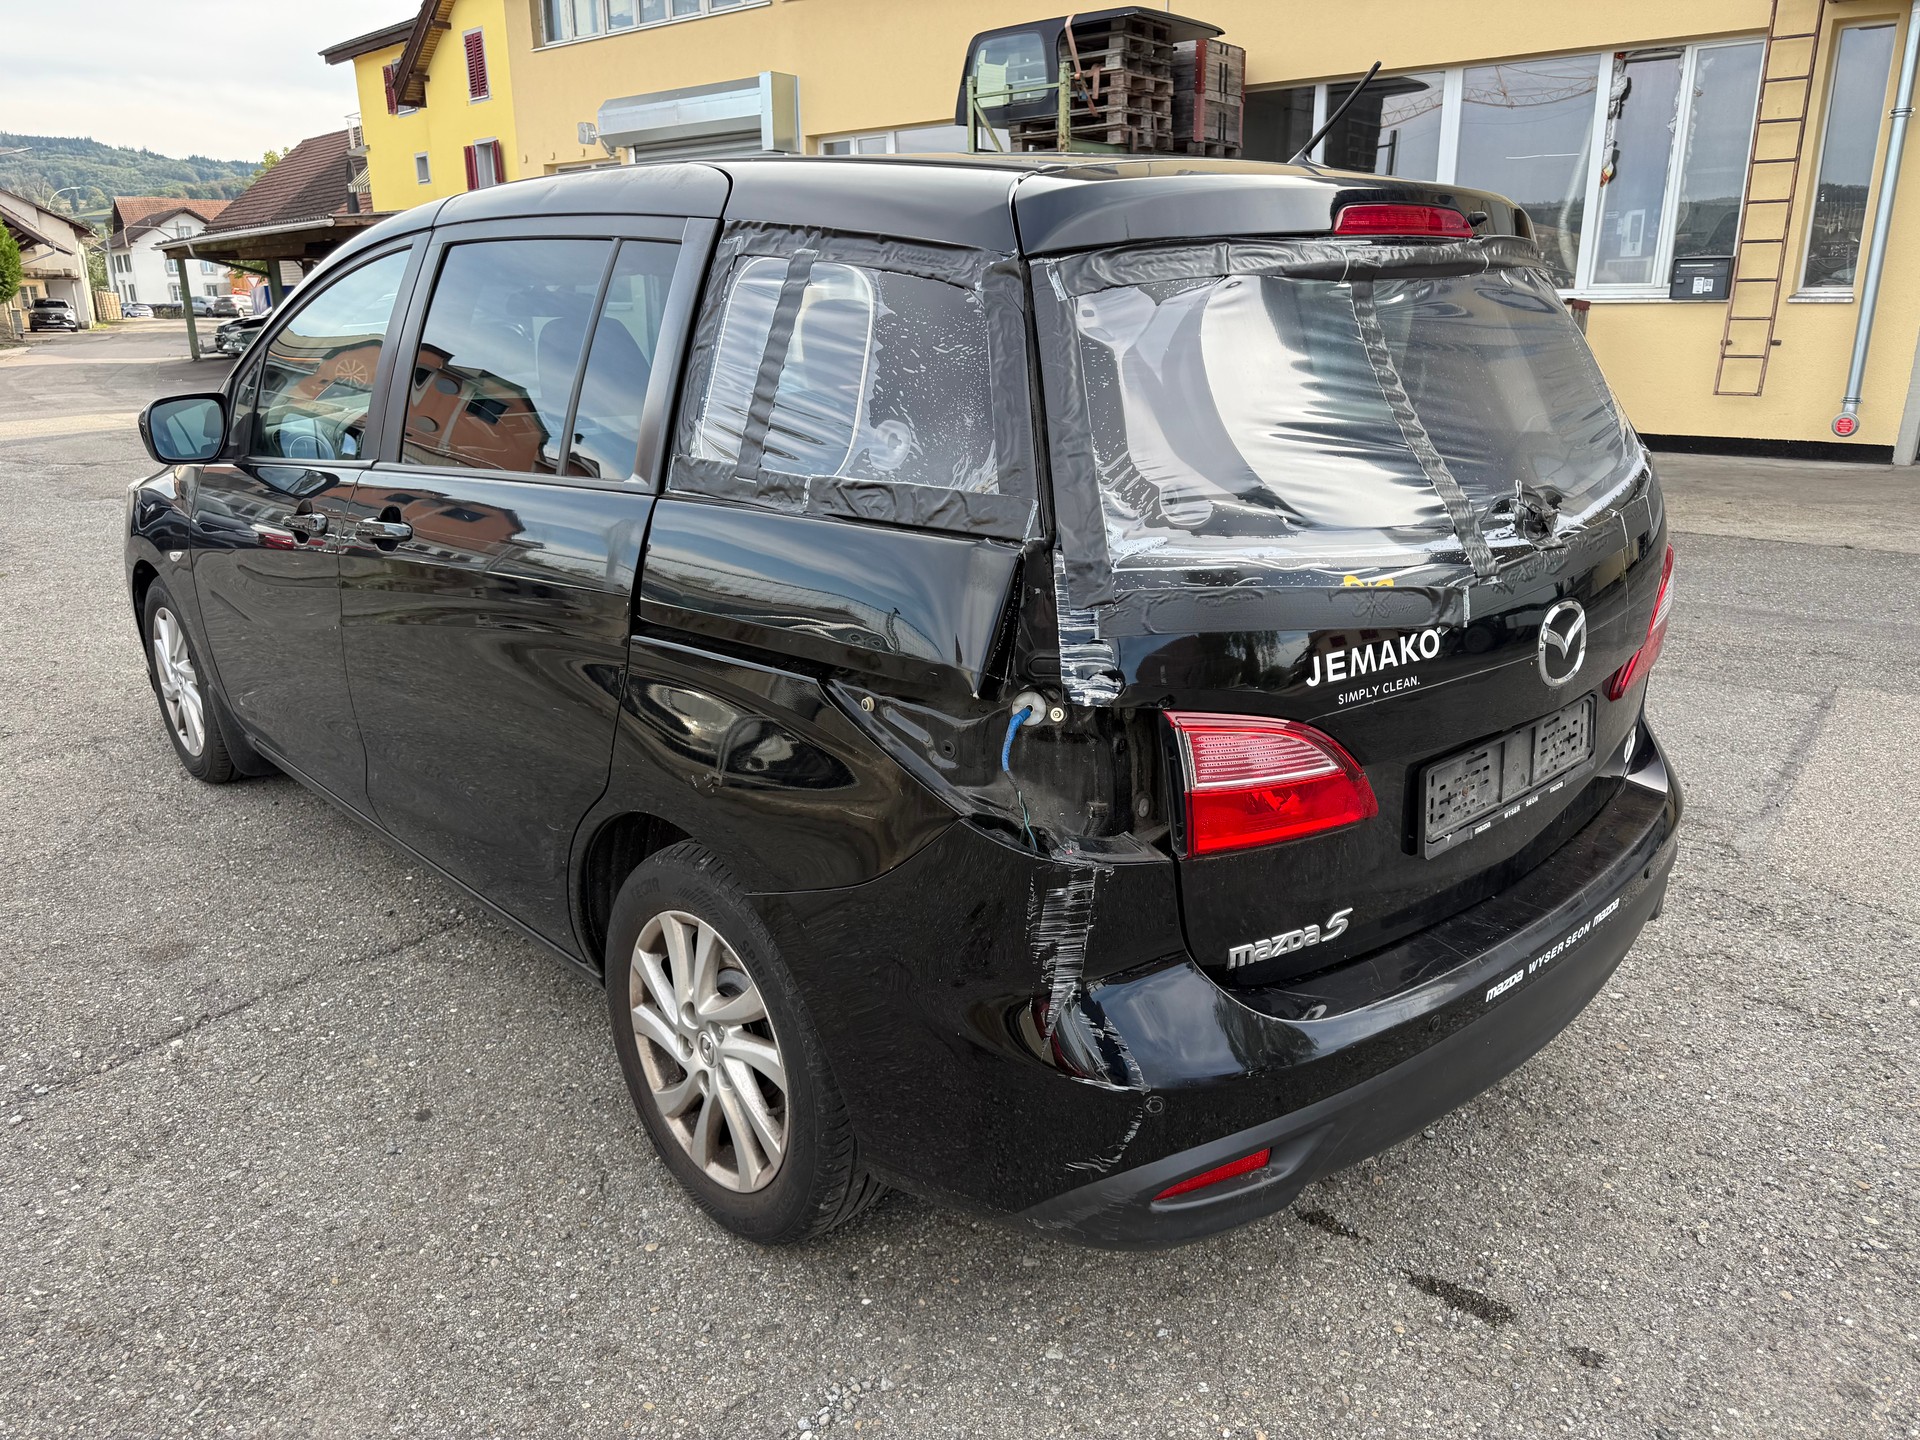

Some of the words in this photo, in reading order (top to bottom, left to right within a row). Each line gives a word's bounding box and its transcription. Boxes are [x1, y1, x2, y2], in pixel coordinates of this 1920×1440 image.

[1306, 629, 1440, 687] JEMAKO
[1338, 685, 1379, 705] SIMPLY
[1382, 675, 1421, 694] CLEAN.
[1504, 805, 1520, 818] WYSER
[1526, 795, 1538, 806] SEON
[1528, 941, 1564, 974] WYSER
[1565, 921, 1591, 948] SEON
